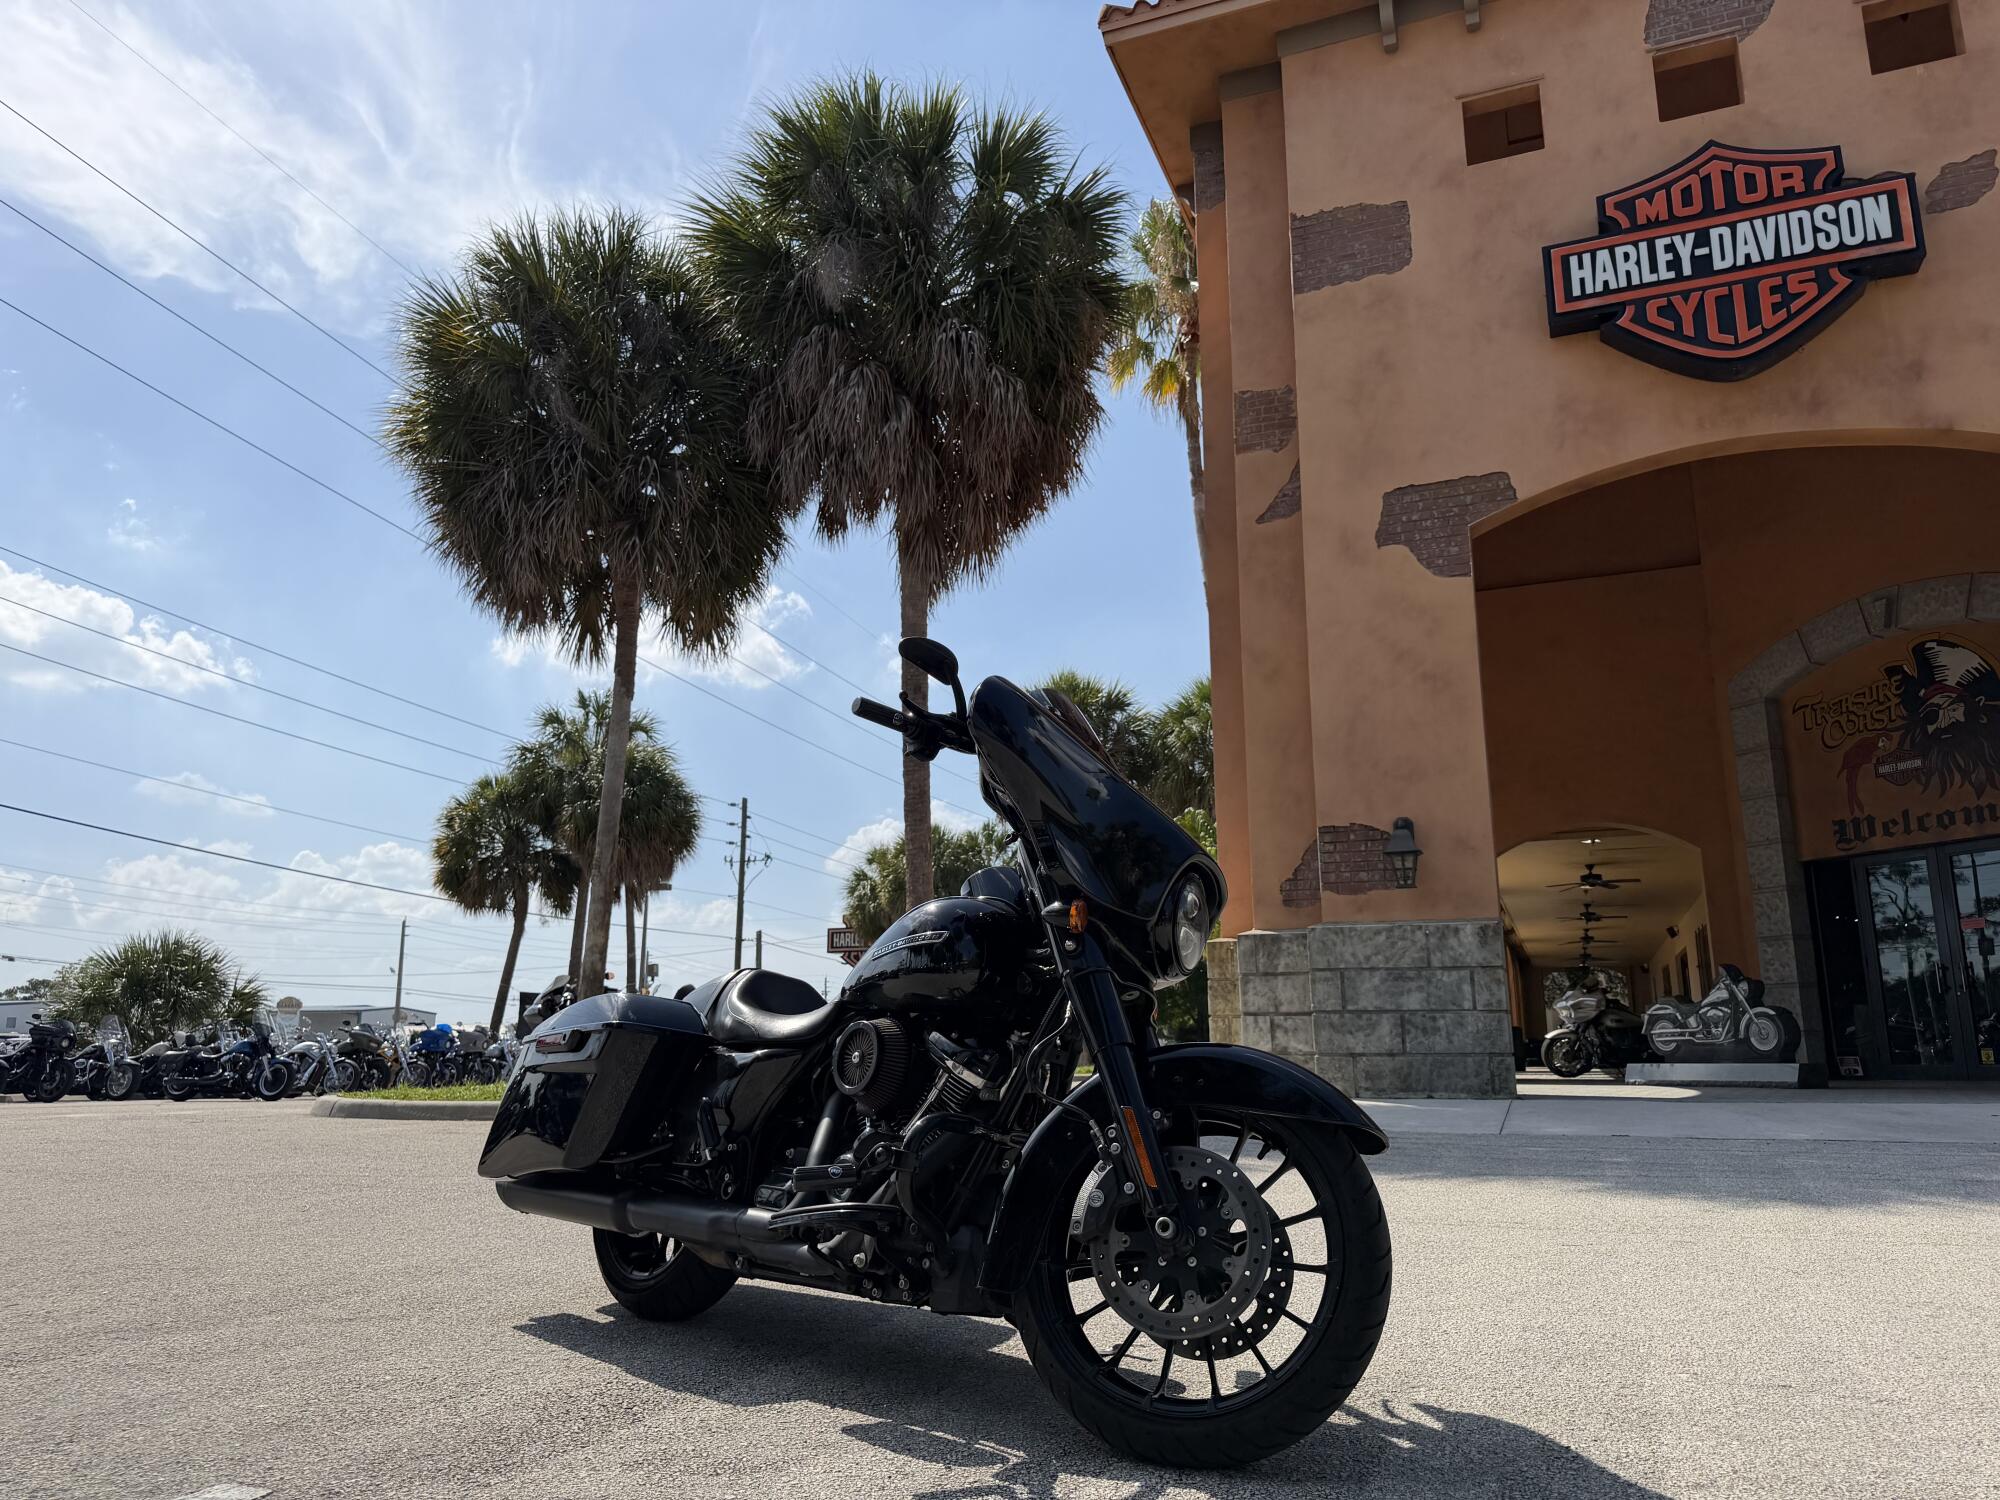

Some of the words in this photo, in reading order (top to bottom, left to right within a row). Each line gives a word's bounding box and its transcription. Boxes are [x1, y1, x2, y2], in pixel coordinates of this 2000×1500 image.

[1635, 159, 1805, 226] MOTOR
[1568, 194, 1892, 297] HARLEY-DAVIDSON
[1646, 270, 1819, 345] CYCLES
[1877, 758, 1922, 775] HARLEY-DAVIDSON
